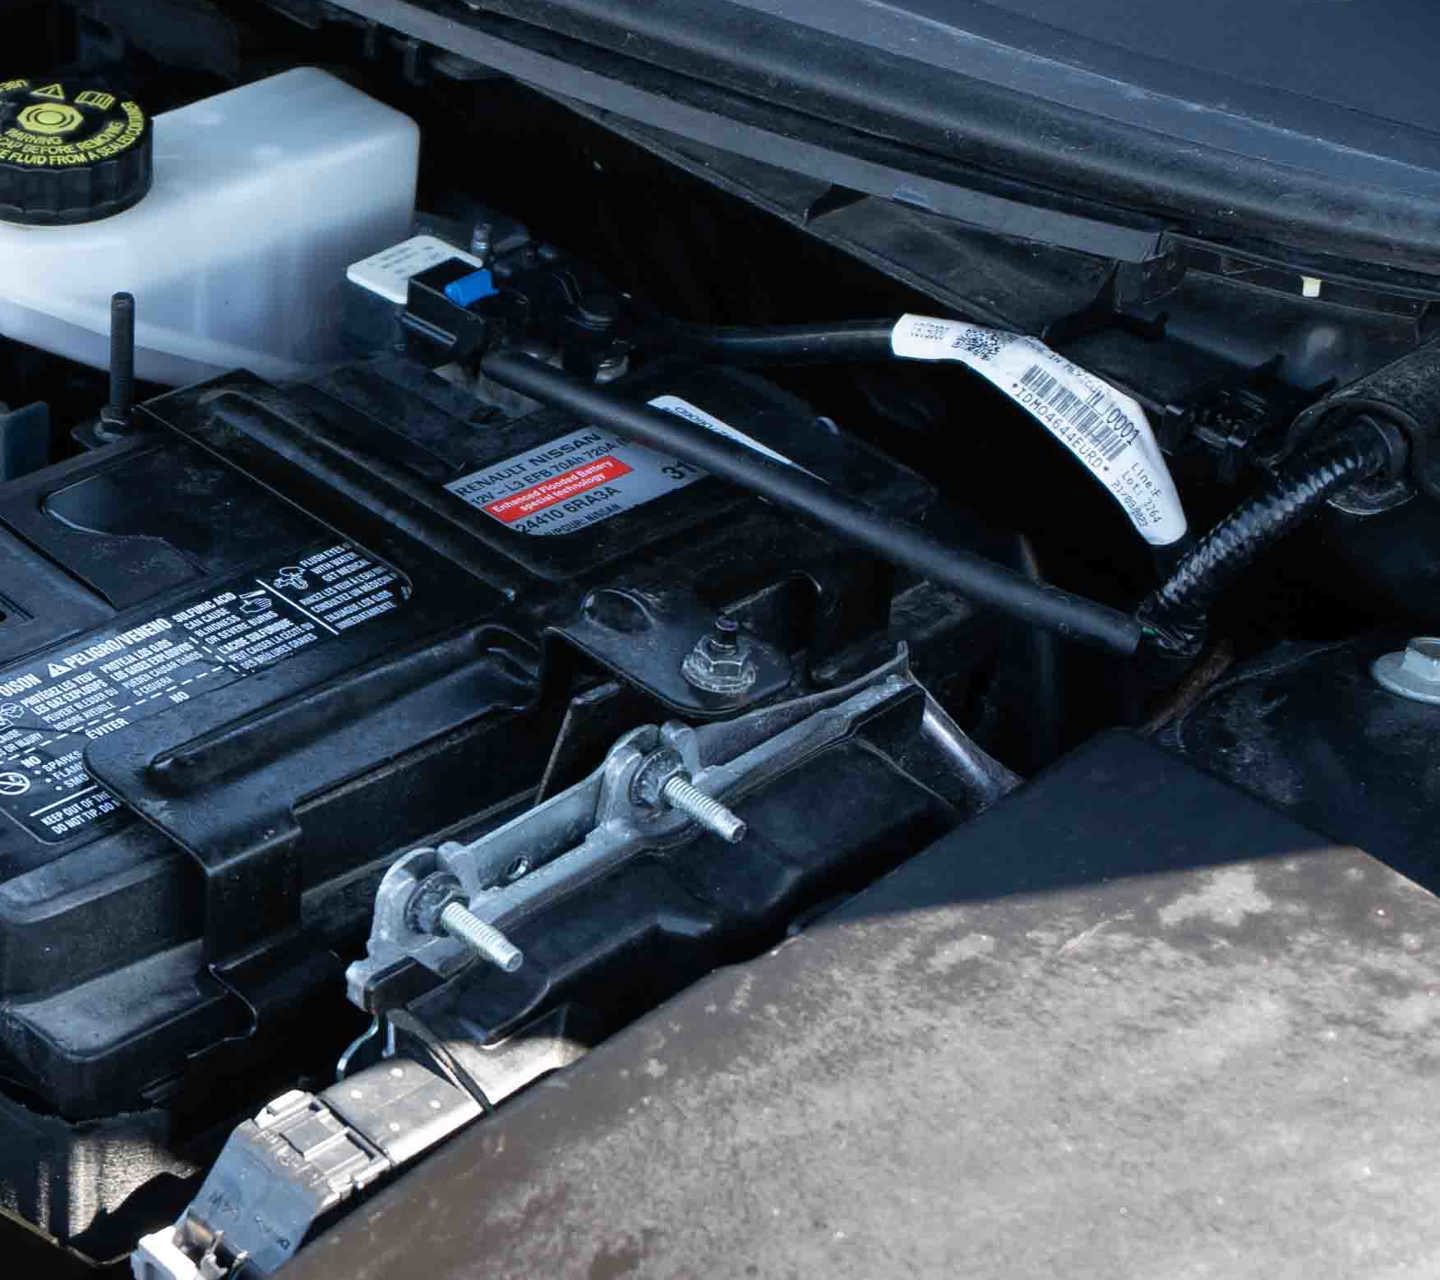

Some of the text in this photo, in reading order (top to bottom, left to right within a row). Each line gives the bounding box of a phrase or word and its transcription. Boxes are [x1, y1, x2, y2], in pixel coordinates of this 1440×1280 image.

[4, 128, 62, 145] WARNING
[8, 151, 47, 165] FLUID
[49, 151, 87, 165] FROM
[87, 151, 100, 160] A
[22, 143, 76, 154] BEFORE
[454, 462, 528, 497] RENAULT
[528, 432, 603, 466] NISSAN
[471, 491, 495, 505] 12V
[523, 468, 552, 484] EFB
[549, 454, 584, 473] 70Ah
[582, 441, 617, 460] 720A
[491, 459, 615, 513] Enhanced Flooded Battery
[519, 472, 607, 511] special technology
[515, 485, 622, 534] 24410 6RA3A
[321, 570, 339, 581] GET
[172, 591, 237, 623] SULFURIC ACID
[183, 607, 231, 630] CAN CAUSE
[193, 613, 241, 638] BLINDNESS
[204, 634, 221, 645] OR
[217, 622, 252, 640] SEVERE
[63, 618, 173, 669] PELIGRO/VENENO
[99, 652, 140, 674] PROTEJA
[133, 646, 153, 660] LOS
[109, 669, 129, 682] LOS
[124, 660, 153, 676] GASES
[57, 679, 77, 692] LES
[72, 670, 99, 685] YEUX
[30, 678, 108, 715] LES GAZ EXPLOSIFS
[169, 690, 191, 704] NO
[84, 717, 130, 740] ÉVITER
[20, 755, 42, 768] NO
[41, 750, 83, 772] SPARKS
[63, 773, 90, 788] SMO
[40, 810, 64, 826] KEEP
[61, 803, 83, 817] OUT
[79, 798, 95, 808] OF
[51, 823, 68, 834] DO
[64, 814, 86, 828] NOT
[97, 802, 115, 813] DO
